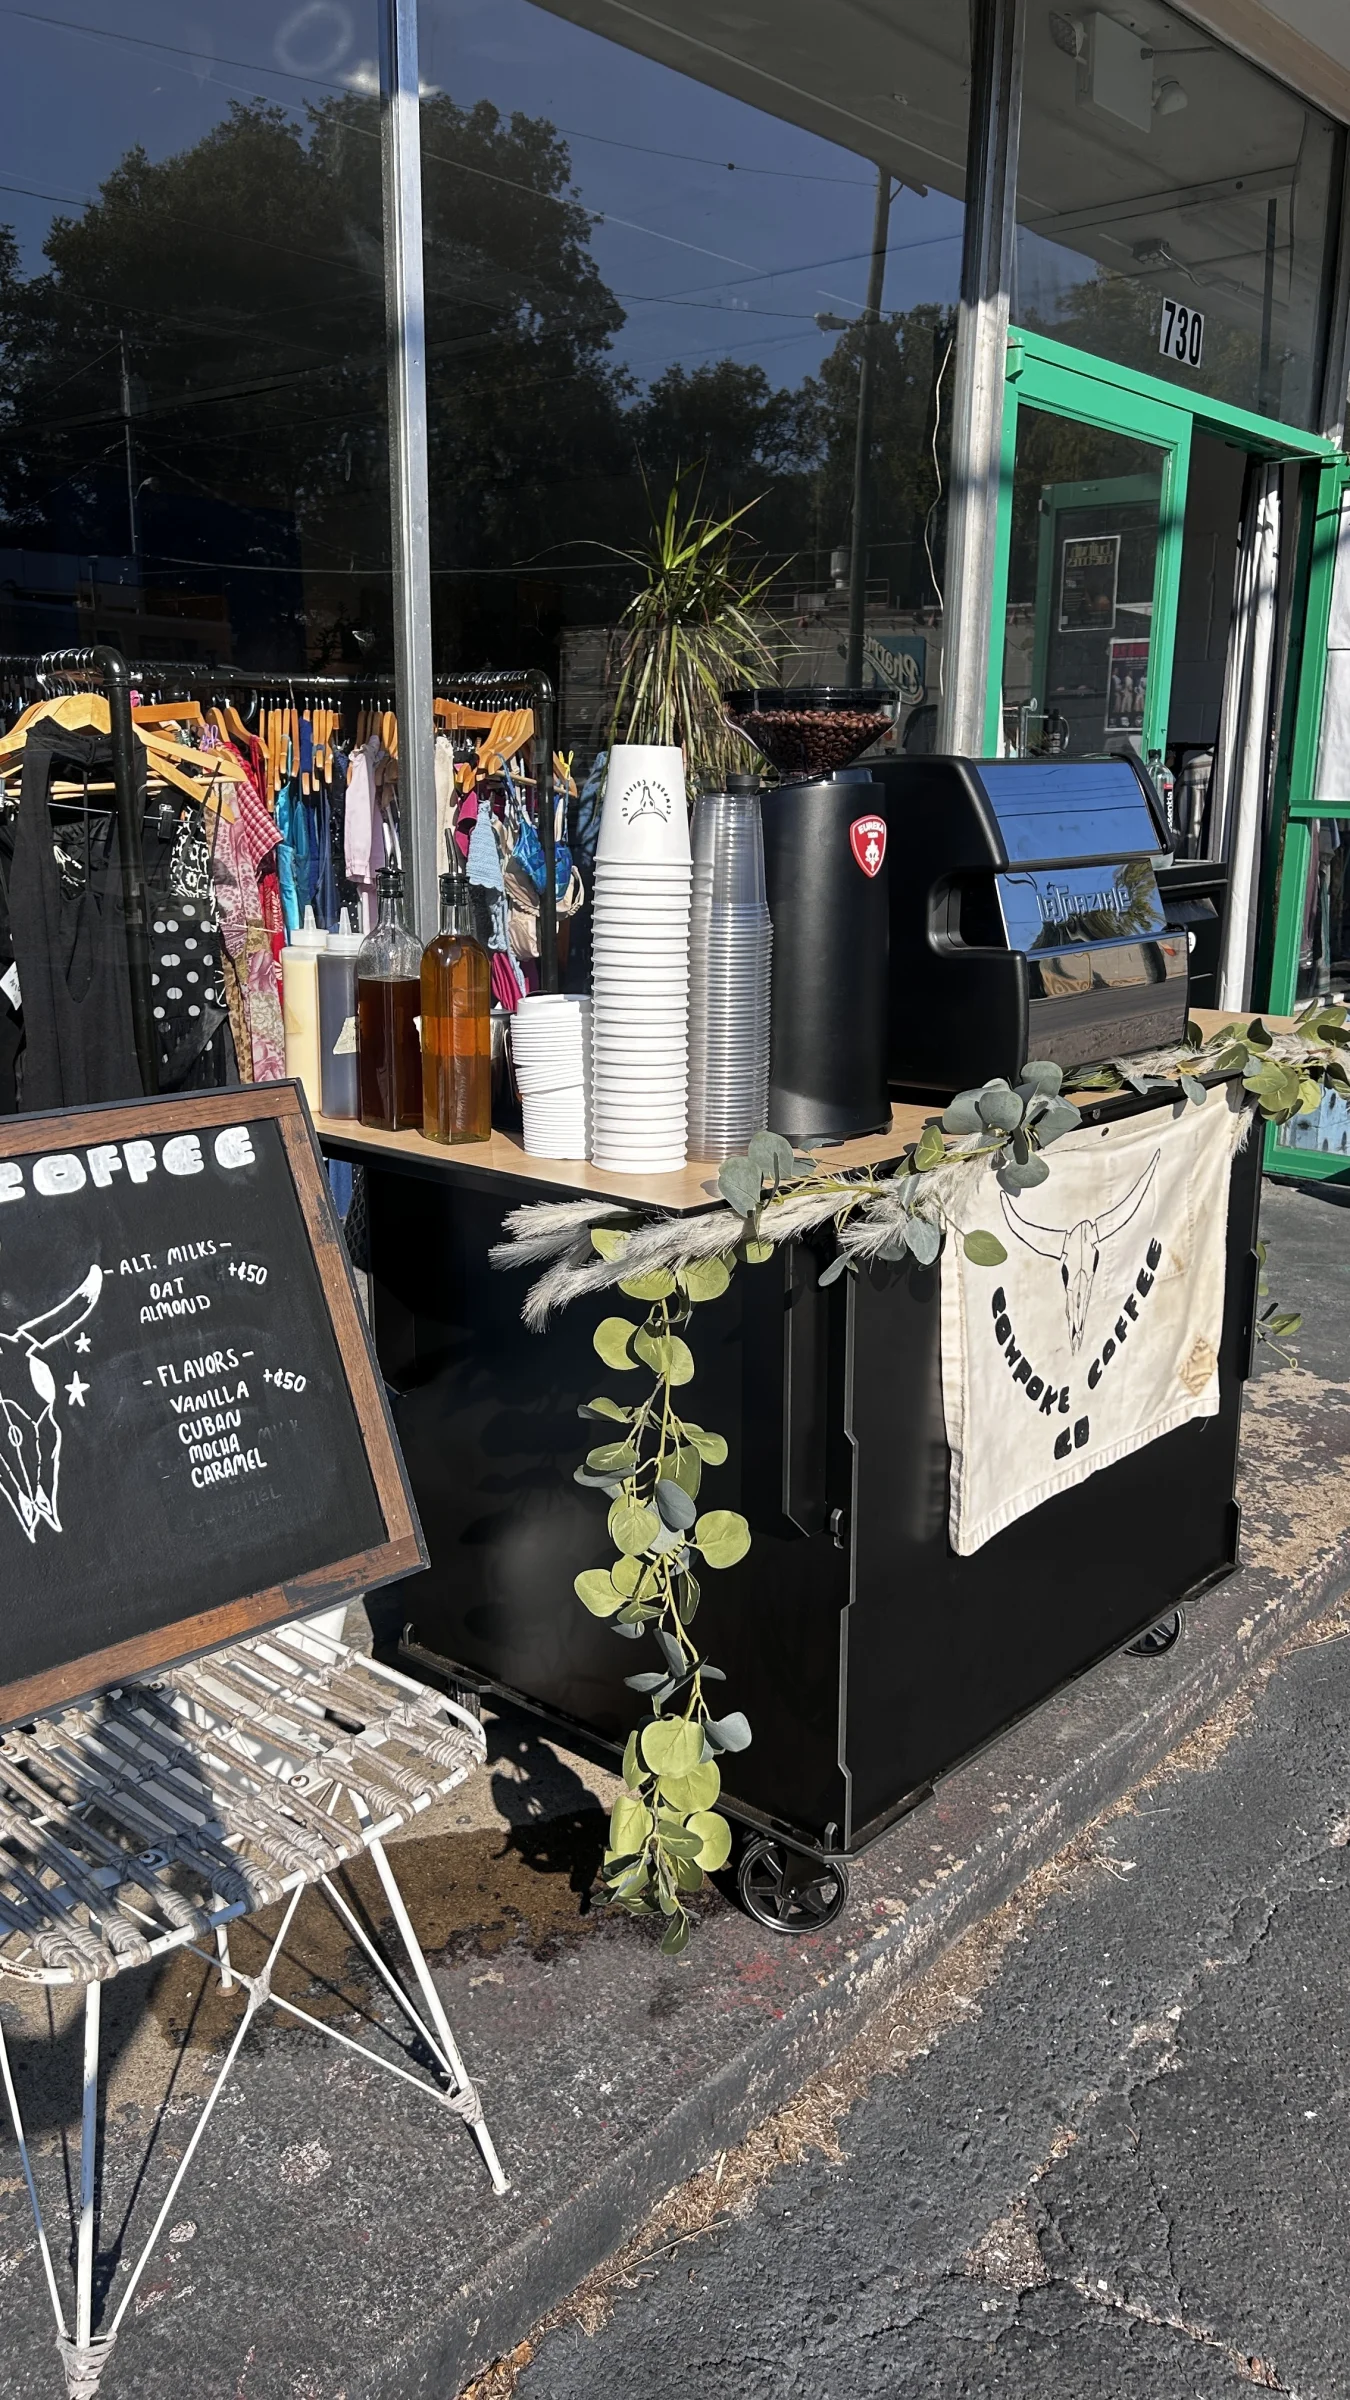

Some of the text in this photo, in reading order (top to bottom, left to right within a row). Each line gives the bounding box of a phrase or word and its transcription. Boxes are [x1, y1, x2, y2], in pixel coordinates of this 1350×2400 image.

[1165, 300, 1202, 365] 730
[1166, 791, 1174, 833] ssentia
[149, 1276, 185, 1301] OAT
[139, 1294, 212, 1324] ALMOND
[991, 1237, 1163, 1416] COWPOKE COFFEE
[169, 1380, 250, 1414] VANILLA
[177, 1408, 243, 1445] CUBAN
[1053, 1415, 1090, 1460] CO
[188, 1432, 241, 1464] MOCHA
[190, 1447, 268, 1489] CARAMEL
